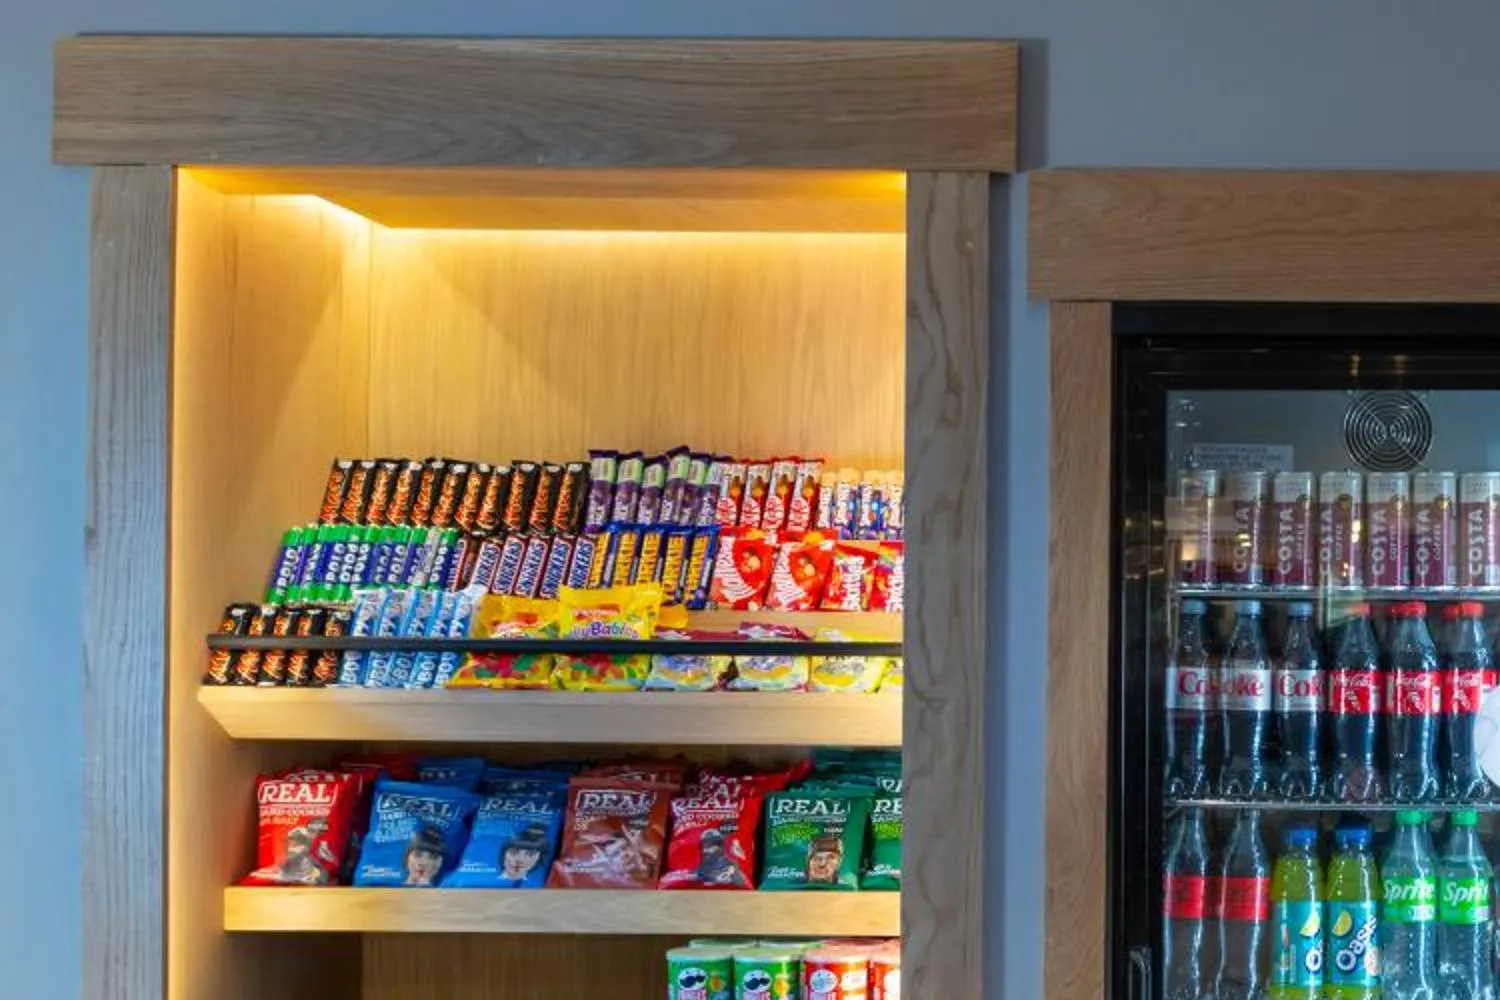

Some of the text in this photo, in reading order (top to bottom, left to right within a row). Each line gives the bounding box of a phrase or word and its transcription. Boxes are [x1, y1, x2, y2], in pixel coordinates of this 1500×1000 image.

[1278, 508, 1294, 575] COSTA
[1320, 508, 1334, 576] COSTA
[1370, 508, 1387, 577] COSTA
[1416, 508, 1432, 577] COSTA
[1468, 508, 1485, 577] COSTA
[261, 784, 331, 802] REAL
[583, 793, 650, 809] REAL
[382, 795, 453, 817] REAL
[484, 798, 553, 815] REAL
[672, 798, 740, 813] REAL
[775, 799, 846, 815] REAL
[873, 799, 902, 814] RE
[1383, 878, 1436, 904] Sprite
